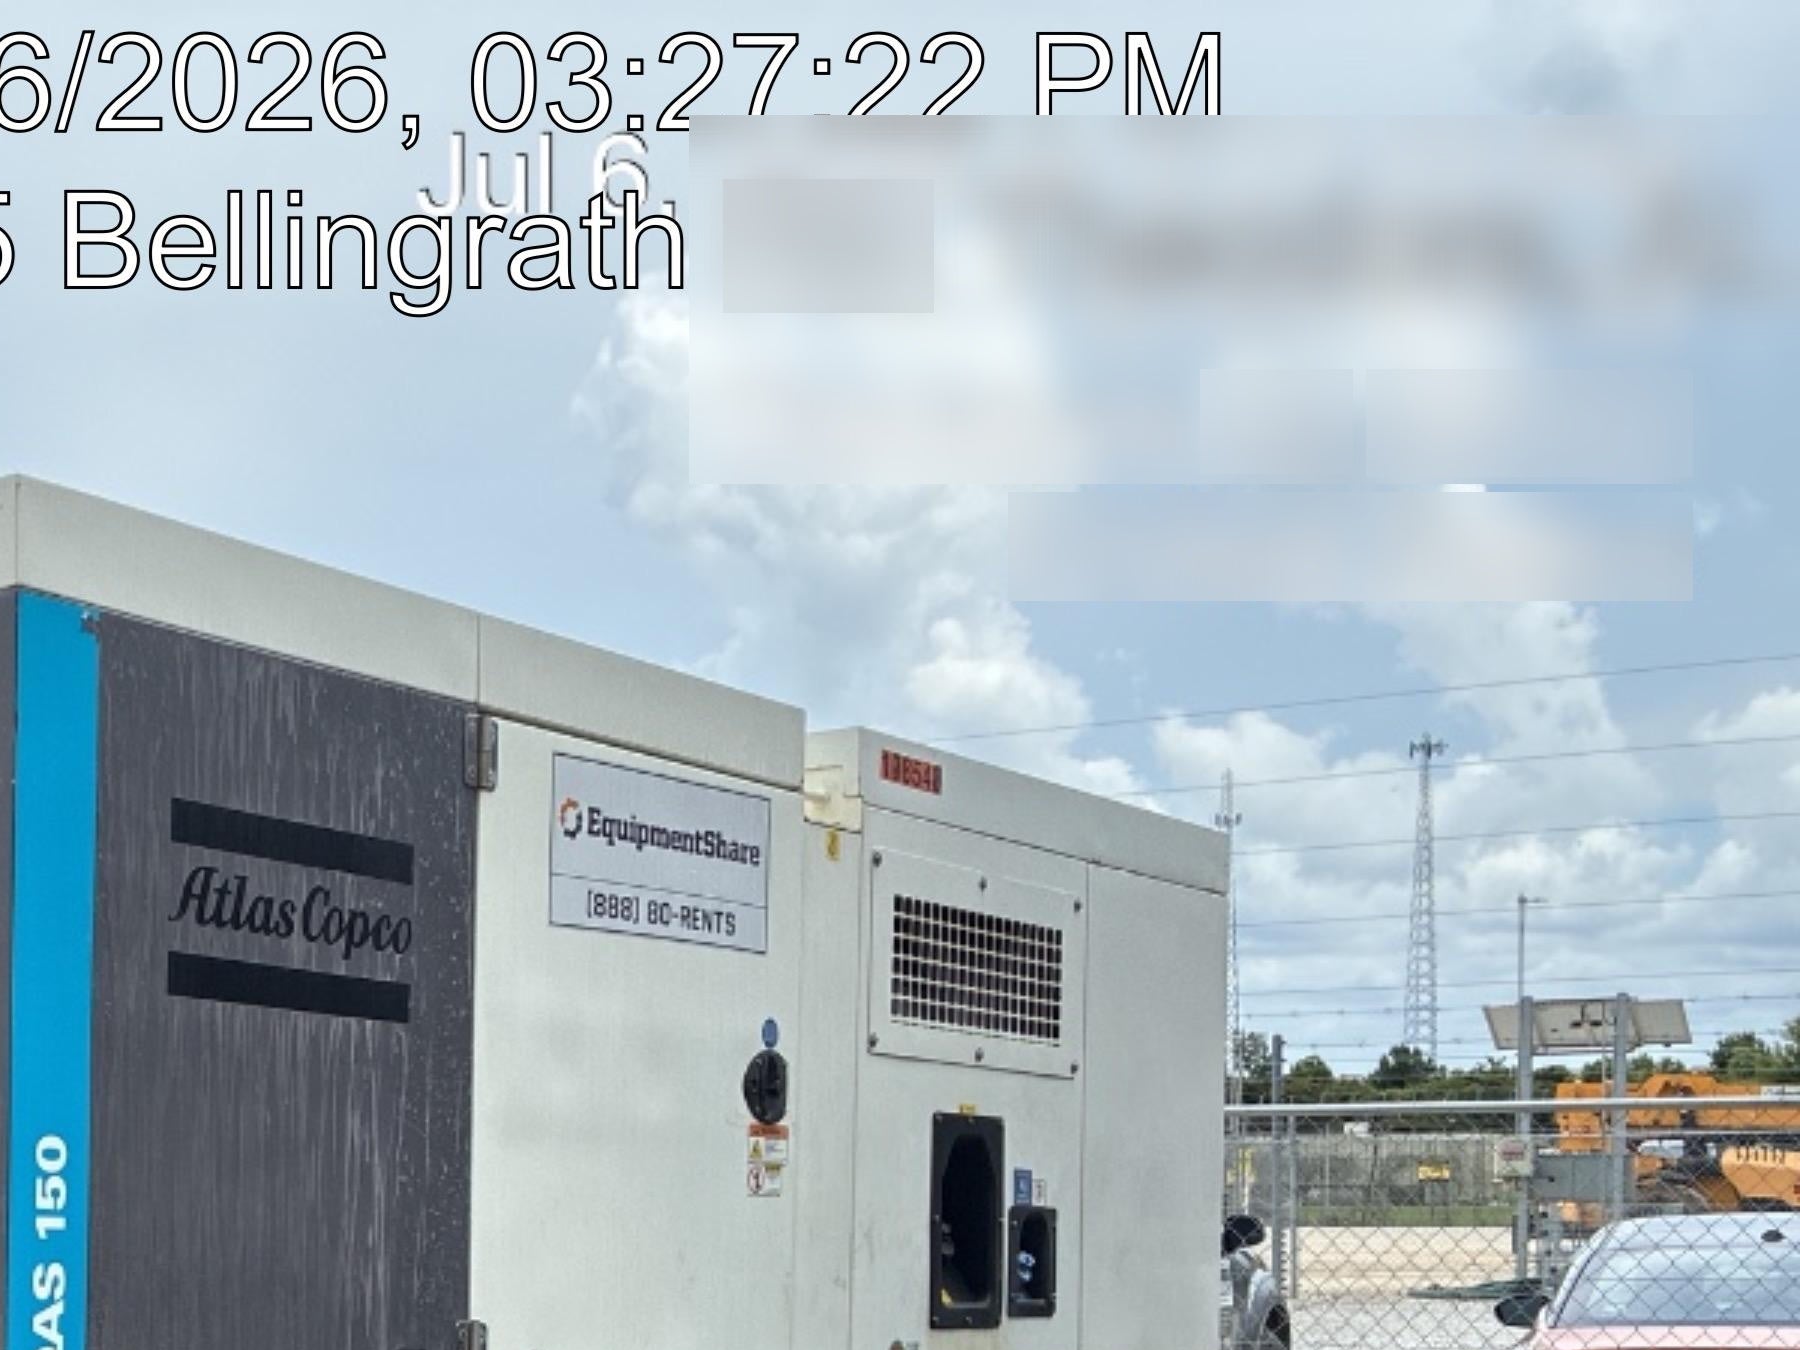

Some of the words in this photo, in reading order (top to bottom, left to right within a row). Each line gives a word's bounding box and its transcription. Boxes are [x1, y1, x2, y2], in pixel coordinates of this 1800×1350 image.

[587, 806, 761, 866] EquipmentShare
[167, 866, 298, 938] Atlas
[302, 884, 413, 960] Copco
[34, 1133, 68, 1240] 150
